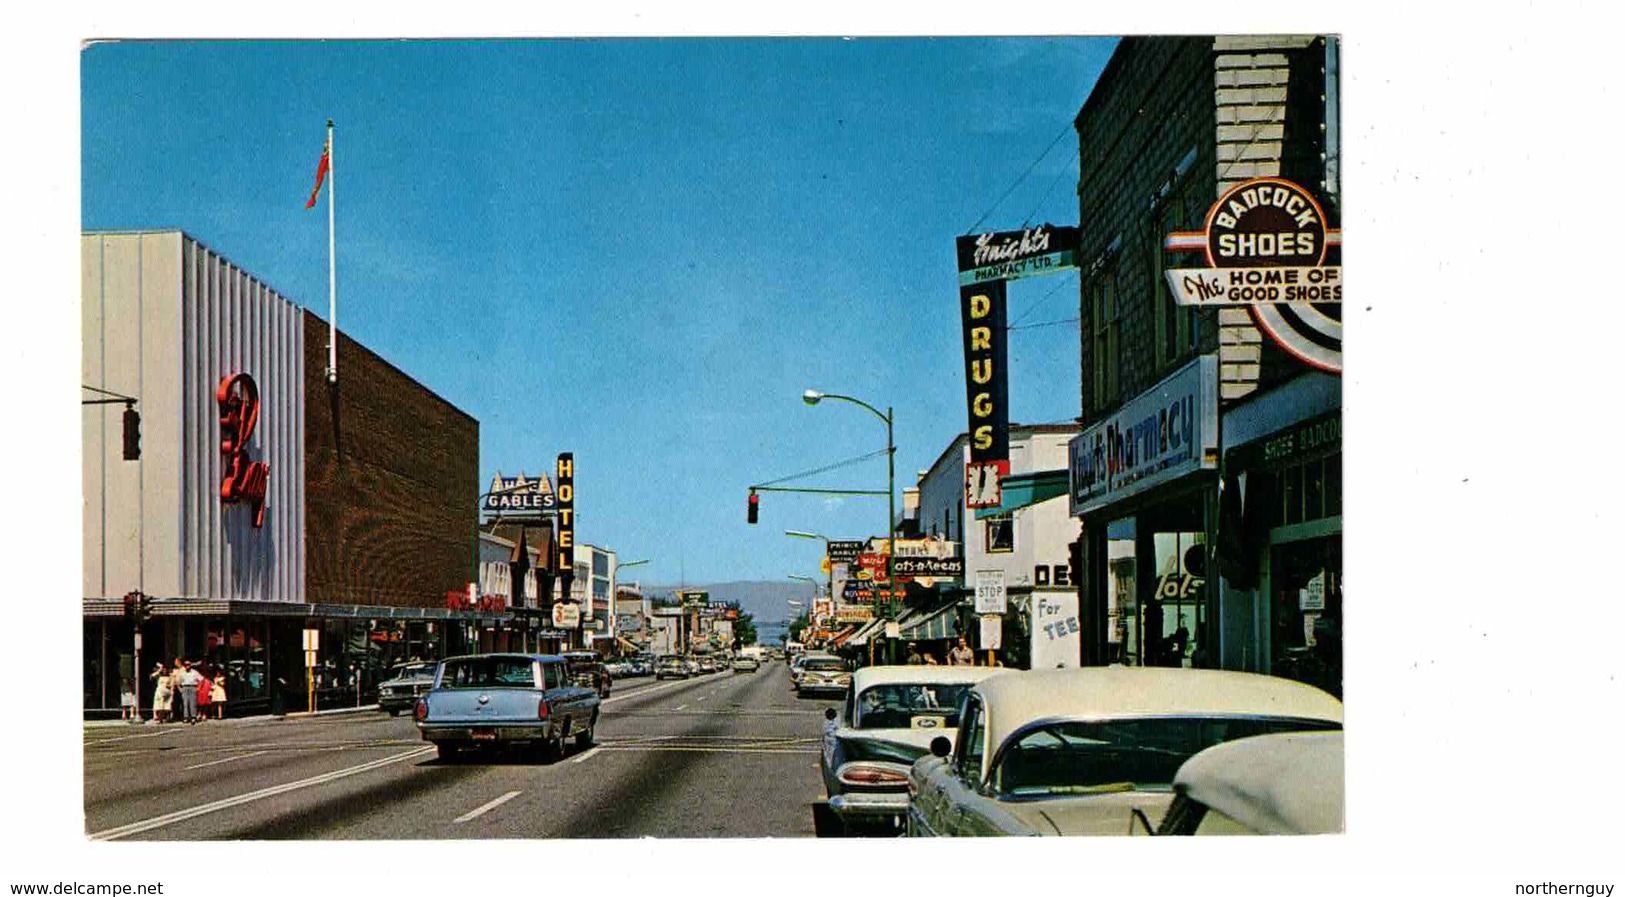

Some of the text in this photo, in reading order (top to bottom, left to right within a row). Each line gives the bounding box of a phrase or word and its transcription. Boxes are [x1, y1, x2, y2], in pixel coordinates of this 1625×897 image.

[1216, 185, 1318, 229] BADCOCK
[973, 226, 1051, 278] Knights
[1219, 232, 1315, 257] SHOES
[975, 260, 1027, 281] PHARMACY
[1230, 269, 1338, 285] HOME OF
[1183, 273, 1225, 303] The
[1227, 285, 1342, 301] GOOD SHOES
[969, 294, 993, 450] DRUGS
[1107, 394, 1193, 493] Pharmacy
[488, 495, 554, 507] GABLES
[558, 459, 573, 570] HOTEL
[894, 559, 961, 572] ots-n-teens
[979, 586, 1002, 598] STOP
